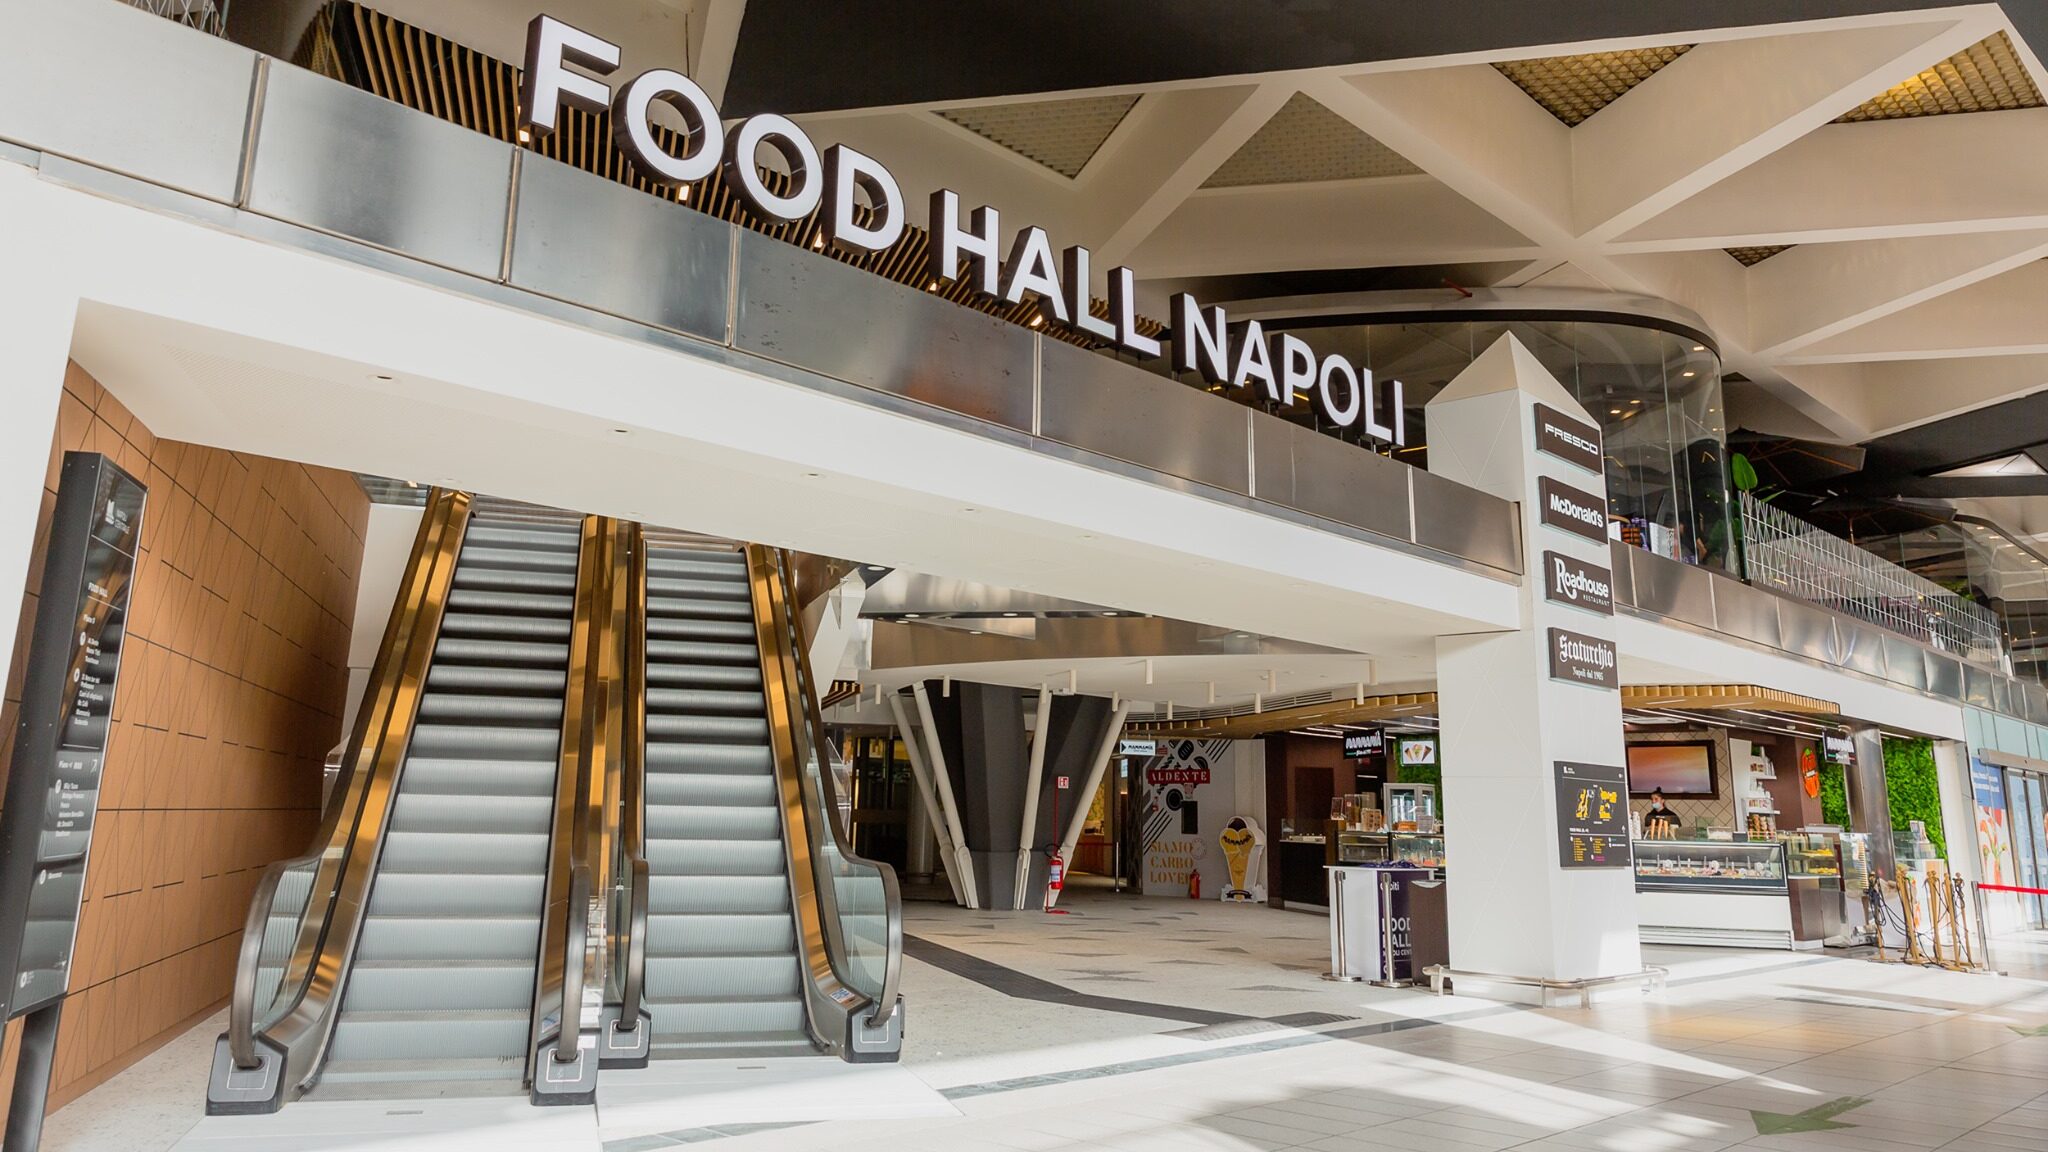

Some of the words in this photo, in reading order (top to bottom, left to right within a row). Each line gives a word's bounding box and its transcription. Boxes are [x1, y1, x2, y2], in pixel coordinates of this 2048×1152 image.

[524, 13, 905, 253] FOOD
[937, 188, 1161, 358] HALL
[1182, 292, 1404, 447] NAPOLI
[1544, 422, 1599, 456] FRESCO
[1550, 492, 1604, 528] McDonald's
[1553, 556, 1609, 600] Roadhouse
[1559, 634, 1614, 670] Scaturchio
[1151, 770, 1208, 781] ALDENTE
[1150, 841, 1193, 853] SIAMO
[1150, 856, 1194, 868] CARBO
